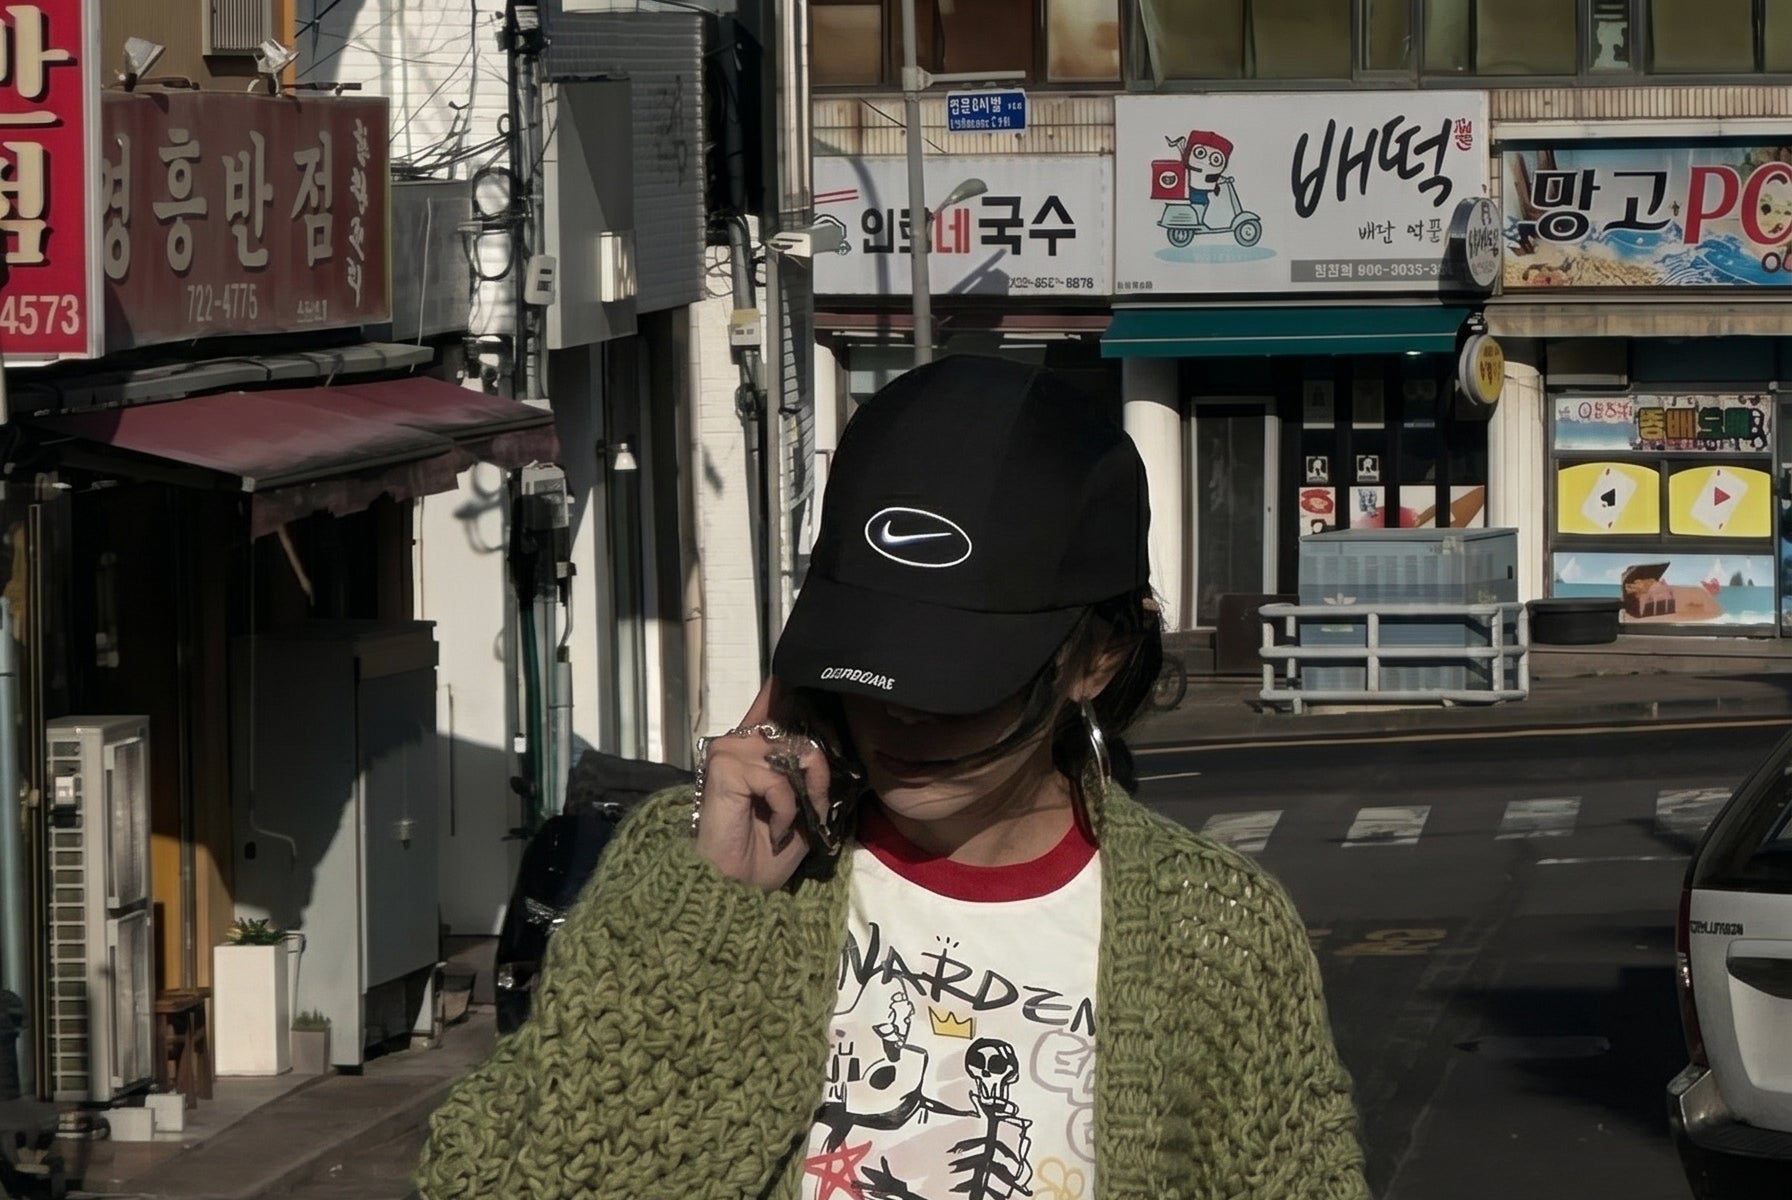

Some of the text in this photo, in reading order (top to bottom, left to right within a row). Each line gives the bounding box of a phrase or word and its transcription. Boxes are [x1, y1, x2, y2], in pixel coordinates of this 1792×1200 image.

[104, 127, 334, 281] 영흥반점
[1291, 114, 1454, 219] 배떡
[1530, 167, 1672, 242] 망고
[0, 294, 80, 335] 4573
[187, 283, 259, 323] 722-4775
